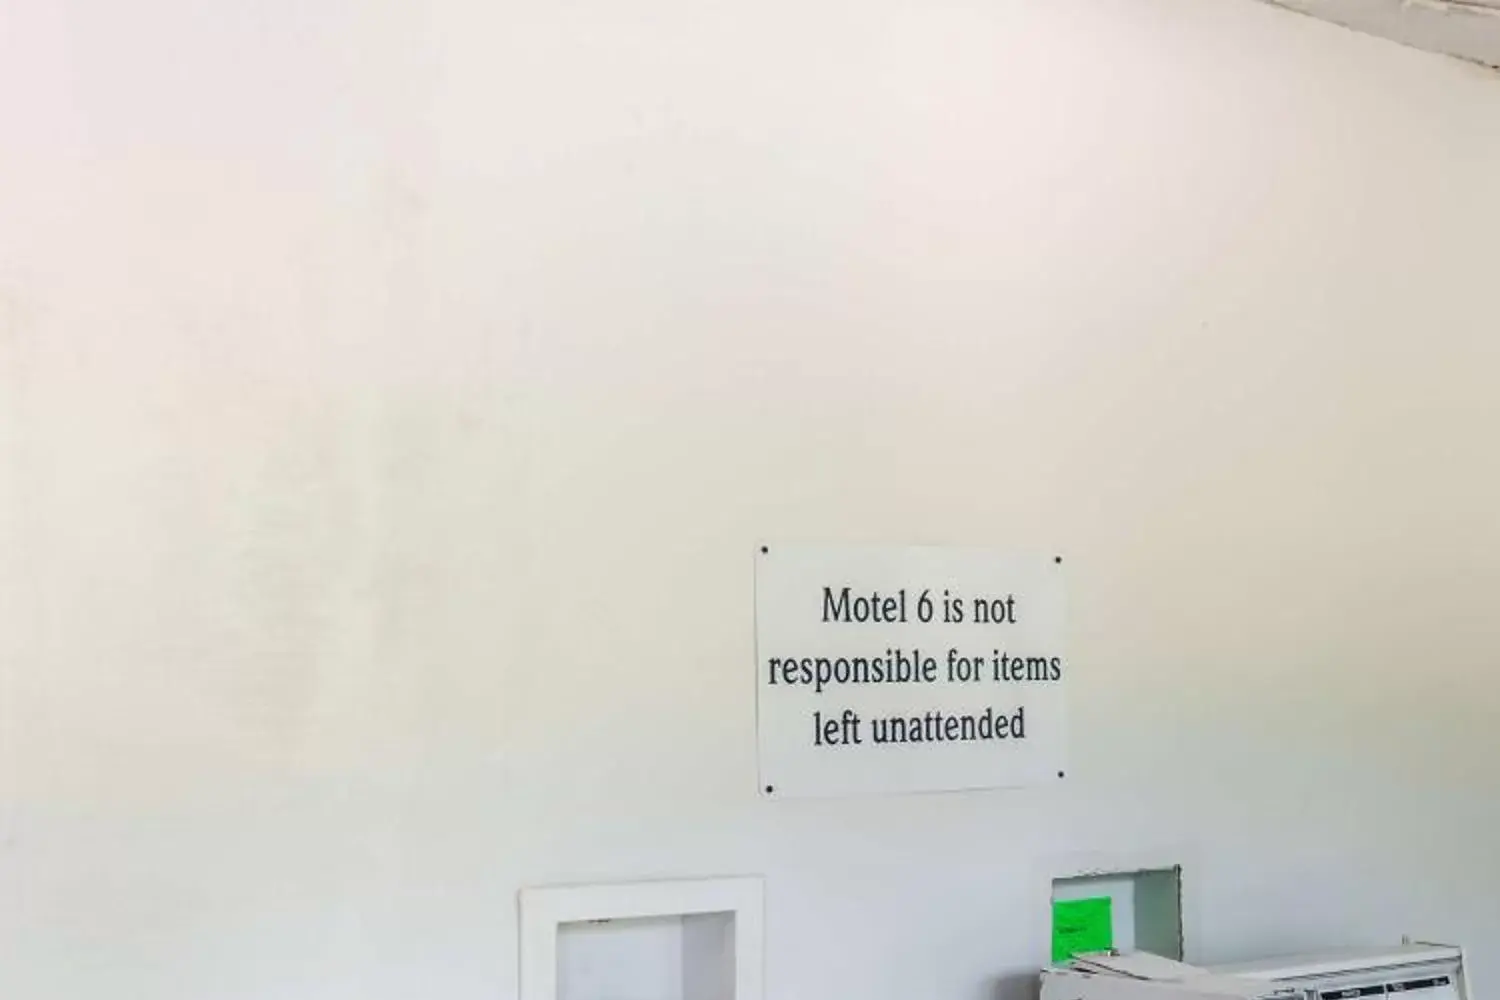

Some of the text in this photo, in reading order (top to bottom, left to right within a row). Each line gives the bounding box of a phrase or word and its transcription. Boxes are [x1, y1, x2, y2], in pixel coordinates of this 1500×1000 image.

[822, 586, 1017, 624] Motel 6 is not
[768, 648, 1061, 693] responsible for items
[813, 706, 1025, 746] left unattended
